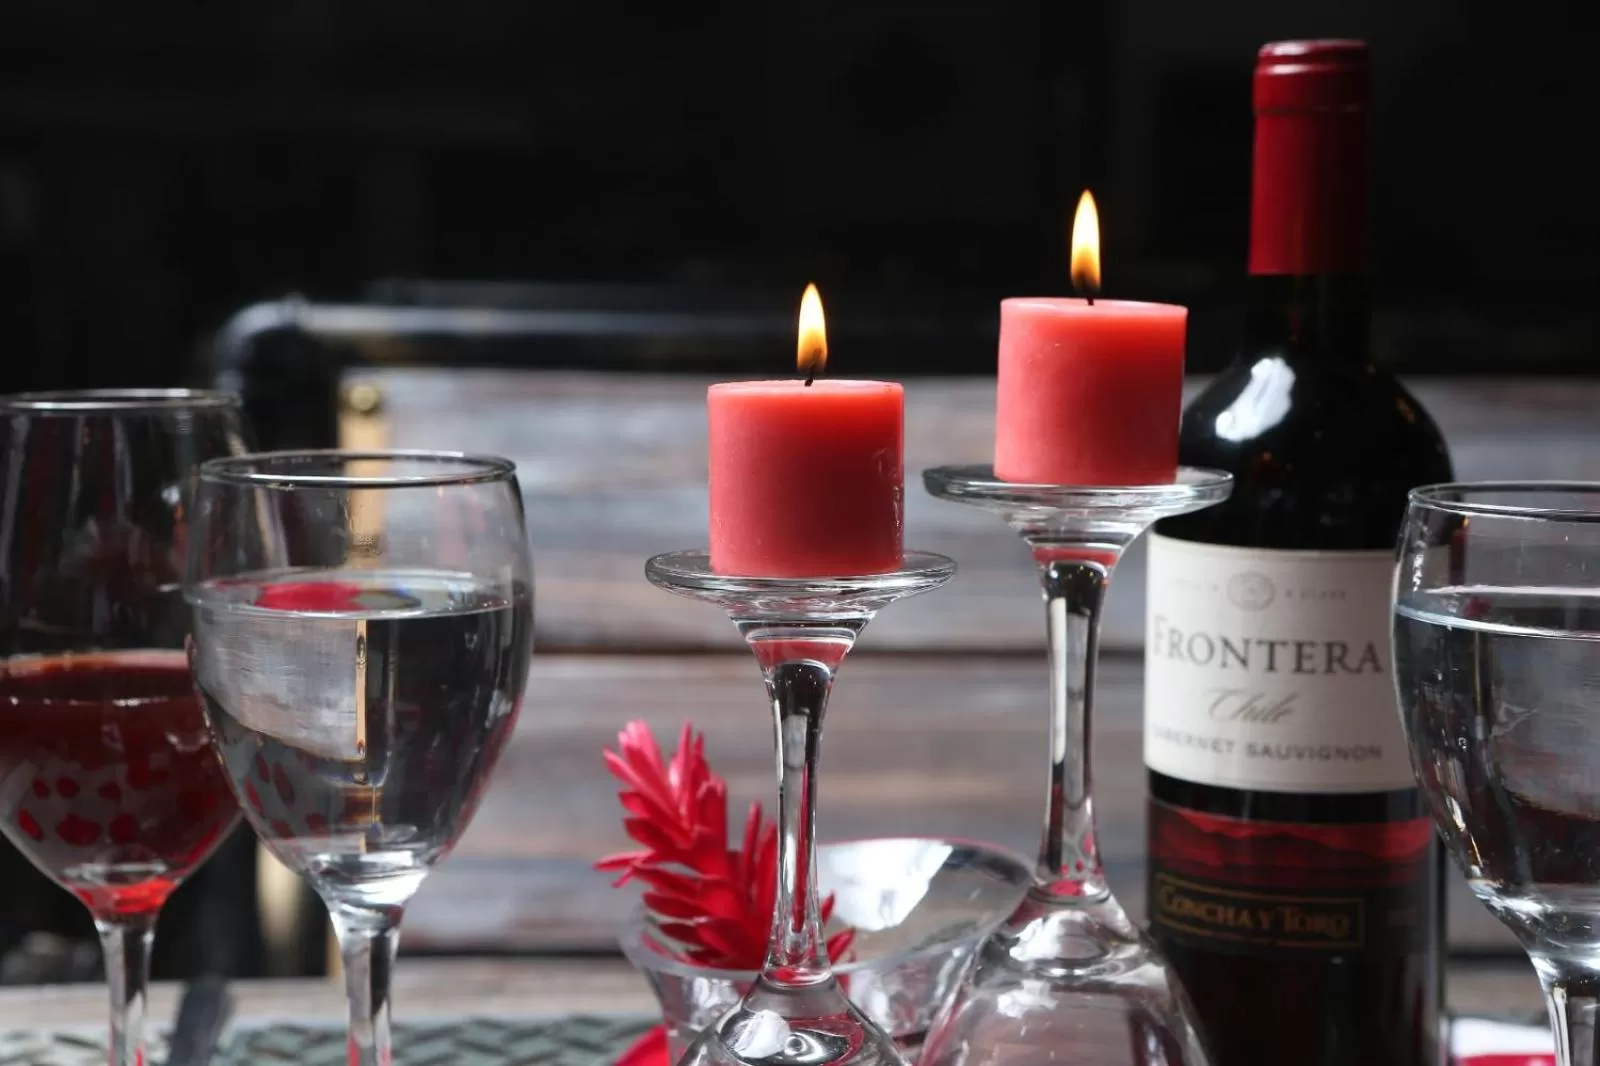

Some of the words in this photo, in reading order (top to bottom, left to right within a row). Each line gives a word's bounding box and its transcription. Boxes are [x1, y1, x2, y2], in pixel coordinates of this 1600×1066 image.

[1154, 616, 1384, 674] FRONTERA
[1208, 687, 1298, 724] Chile
[1246, 741, 1383, 761] SAUVIGNON
[1157, 886, 1254, 929] CONCHA
[1276, 906, 1351, 938] TORO
